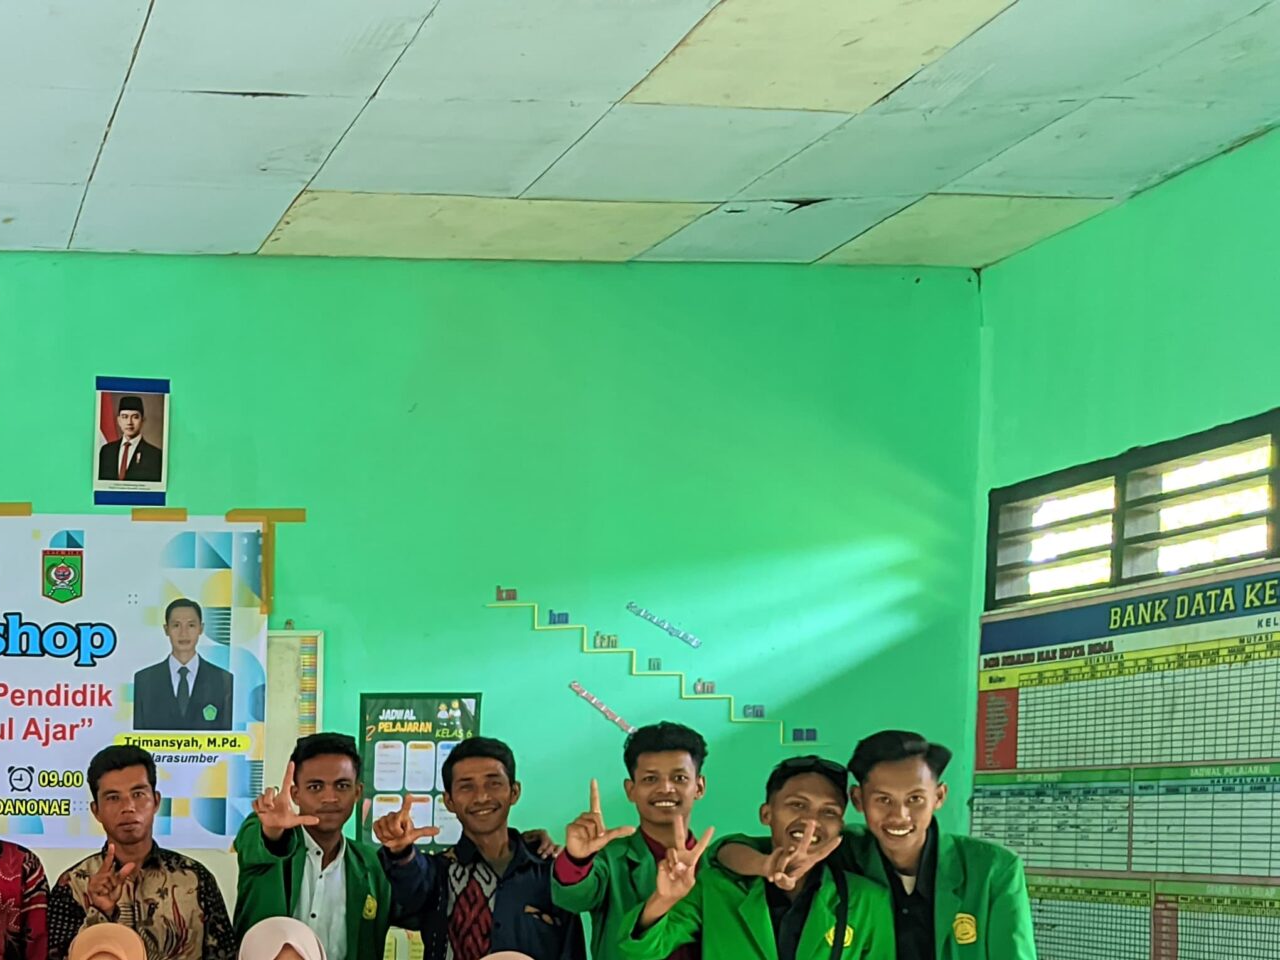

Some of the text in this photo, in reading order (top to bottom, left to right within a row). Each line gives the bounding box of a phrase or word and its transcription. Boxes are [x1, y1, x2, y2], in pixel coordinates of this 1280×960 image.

[495, 585, 517, 601] km
[1108, 598, 1169, 630] BANK
[1175, 586, 1236, 620] DATA
[548, 609, 569, 625] hm
[693, 678, 715, 694] dm
[378, 709, 416, 721] JADWAL
[378, 721, 432, 733] PELAJARAN
[435, 729, 473, 739] KELAS 6
[124, 736, 241, 749] Trimansyah, M.Pd.
[38, 770, 84, 787] 09.00
